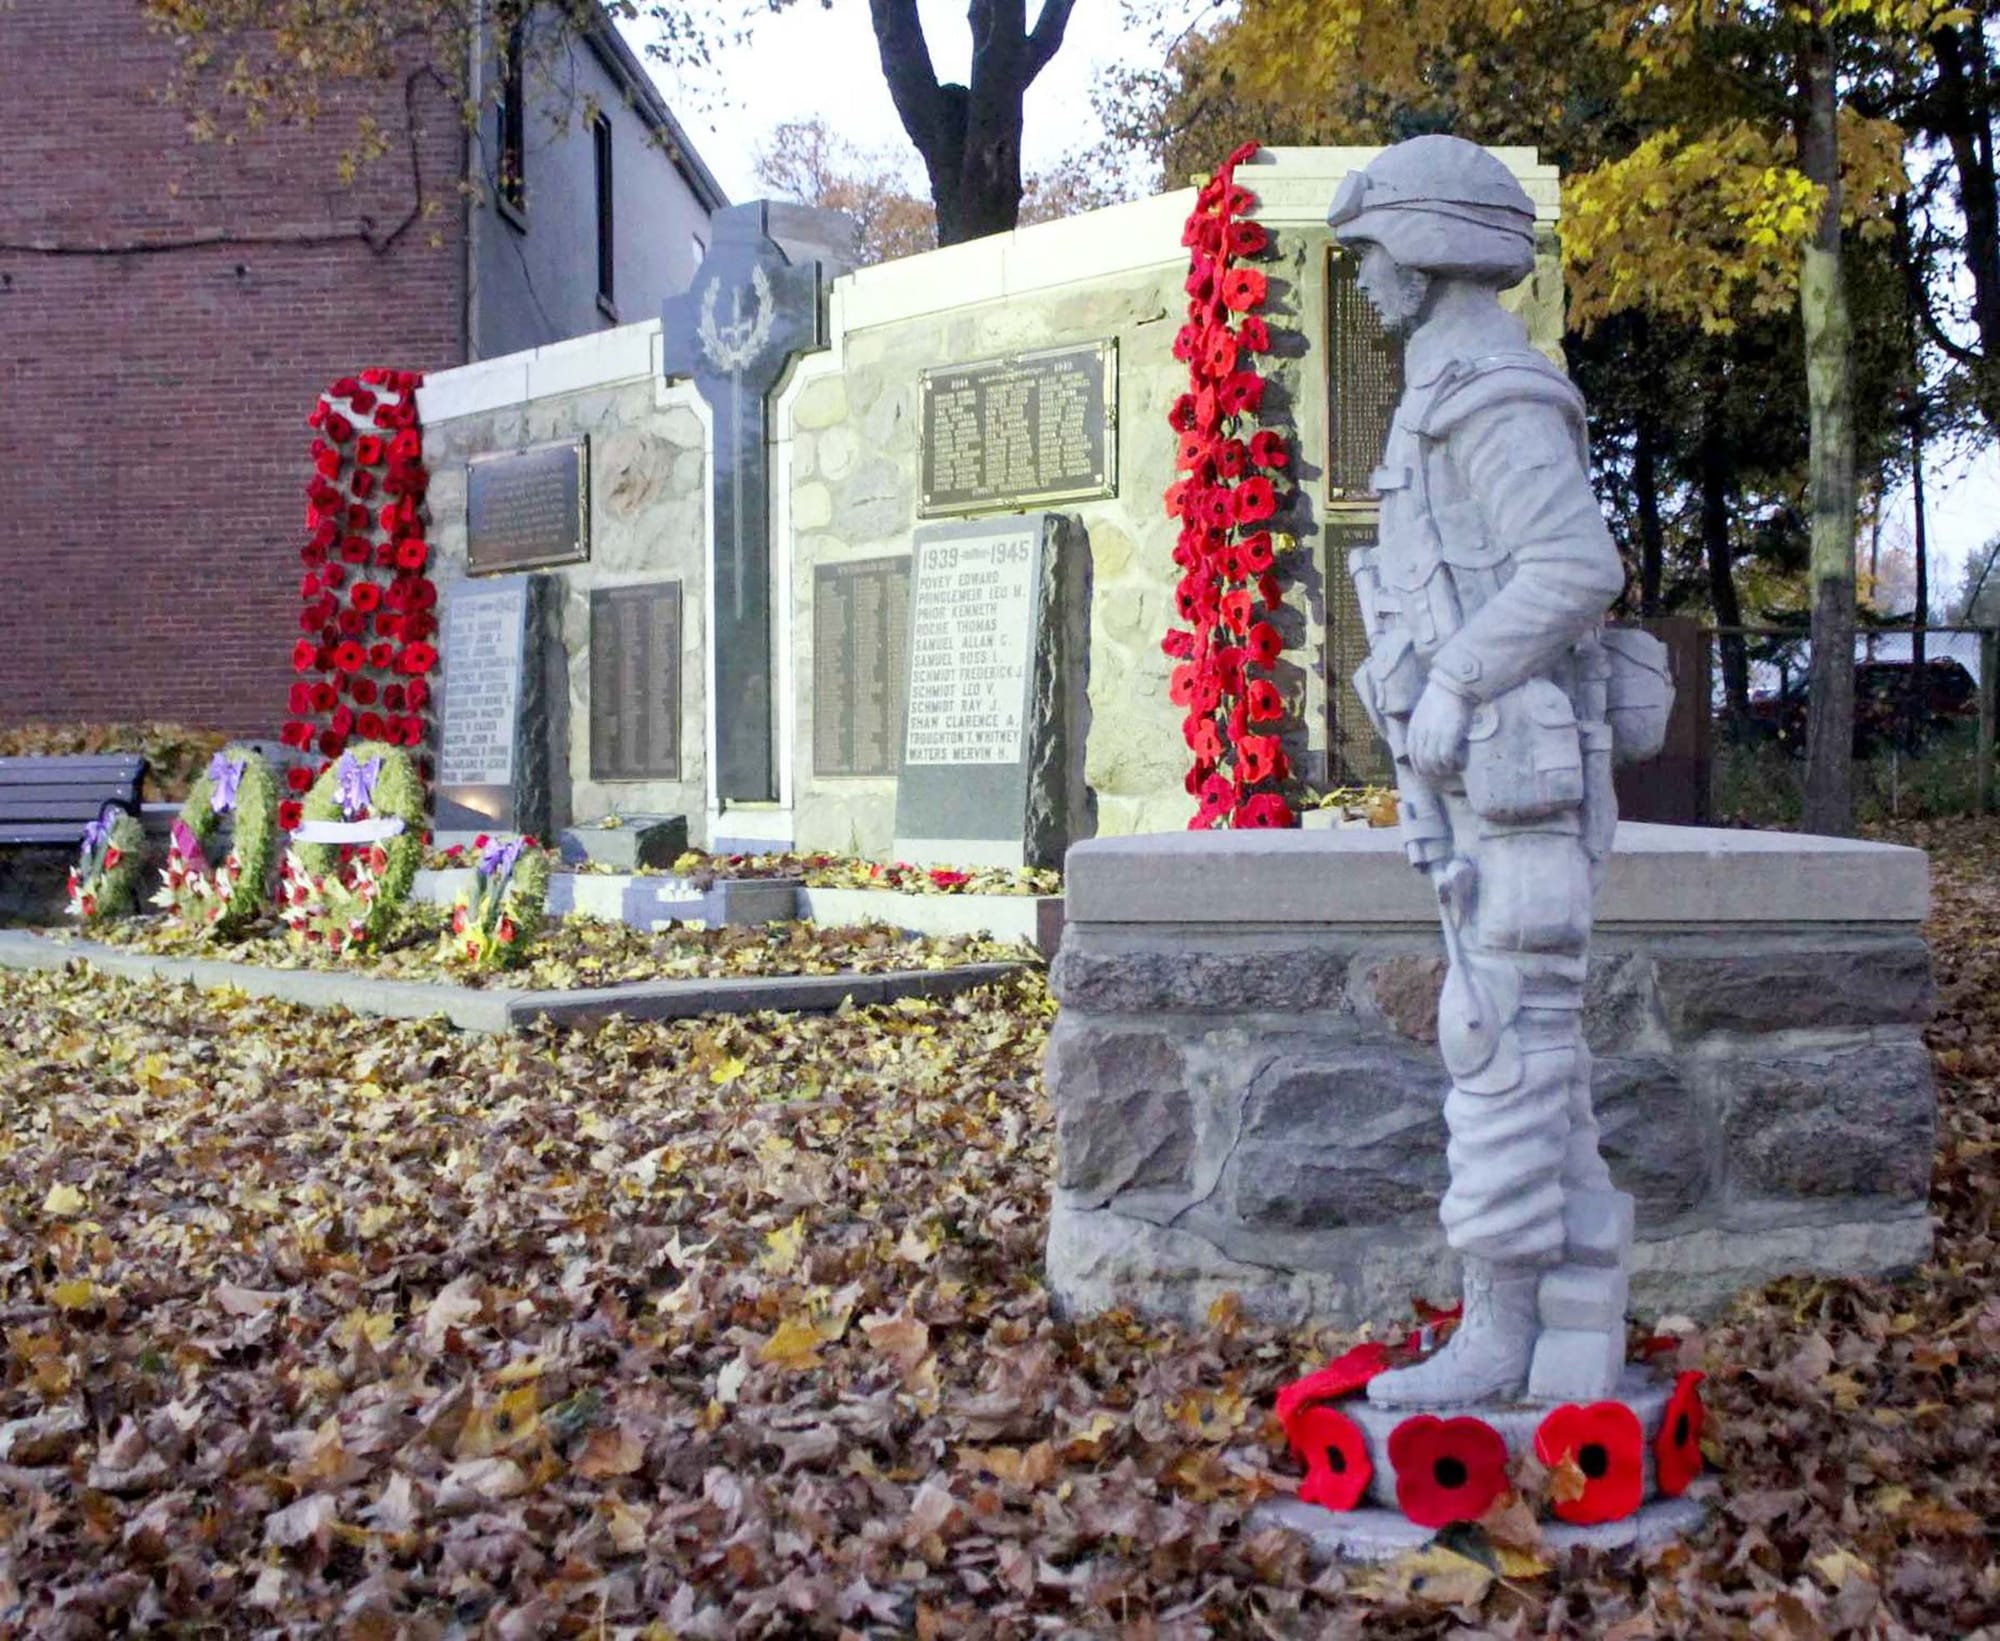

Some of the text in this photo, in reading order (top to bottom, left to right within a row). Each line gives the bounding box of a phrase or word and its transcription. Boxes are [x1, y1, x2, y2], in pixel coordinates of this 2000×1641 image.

[923, 540, 1029, 569] 1939 1945
[959, 570, 1000, 586] EDWARD
[990, 586, 1008, 599] LEO
[952, 602, 997, 617] KENNETH
[956, 619, 997, 633] THOMAS
[915, 637, 953, 651] SAMUEL
[961, 634, 994, 648] ALLAN
[914, 652, 952, 667] SAMUEL
[960, 650, 987, 664] ROSS
[913, 669, 954, 683] SCHMIDT
[959, 666, 1012, 680] FREDERICK
[912, 684, 954, 698] SCHMIDT
[963, 683, 980, 696] LEO
[911, 700, 954, 713] SCHMIDT
[962, 699, 982, 712] RAY
[911, 713, 1020, 729] SHAW CLARENCE A.
[909, 747, 947, 760] WATERS
[953, 746, 991, 760] MERVIN
